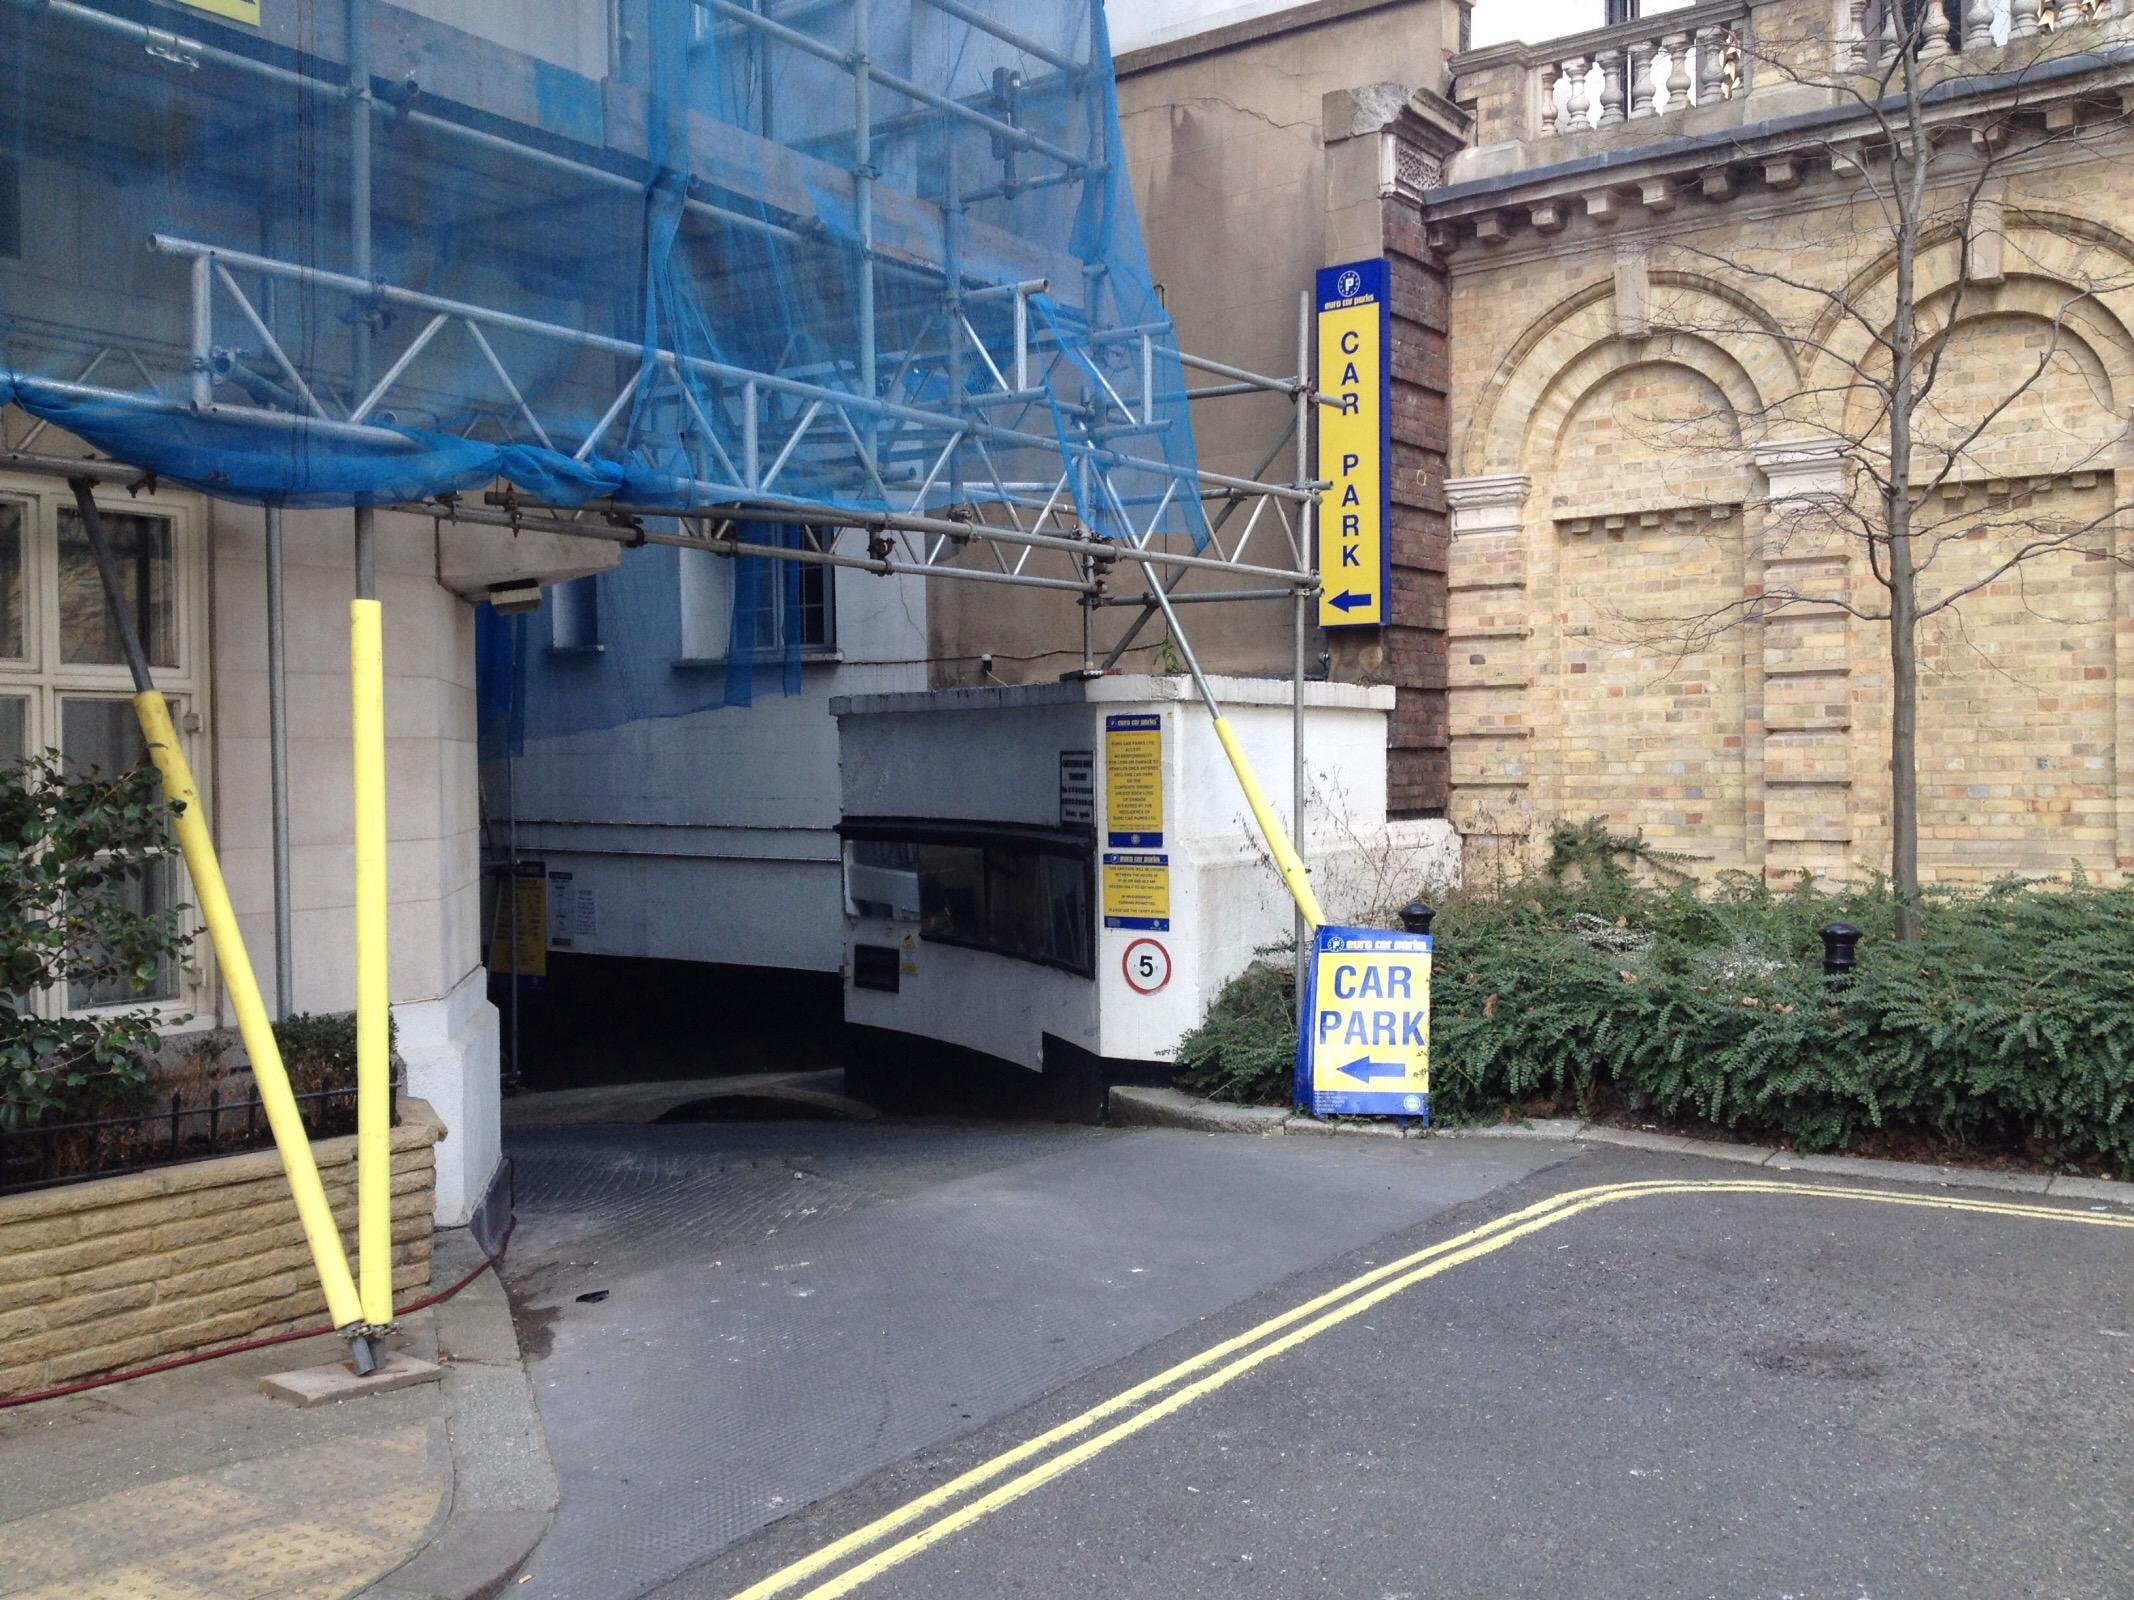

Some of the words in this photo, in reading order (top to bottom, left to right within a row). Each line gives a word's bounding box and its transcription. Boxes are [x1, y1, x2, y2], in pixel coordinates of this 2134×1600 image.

[1341, 331, 1359, 416] CAR
[1341, 453, 1360, 567] PARK
[1346, 940, 1372, 949] euro
[1375, 940, 1392, 949] car
[1394, 939, 1427, 950] parks
[1139, 955, 1153, 977] 5
[1334, 965, 1412, 999] CAR
[1319, 1010, 1425, 1046] PARK
